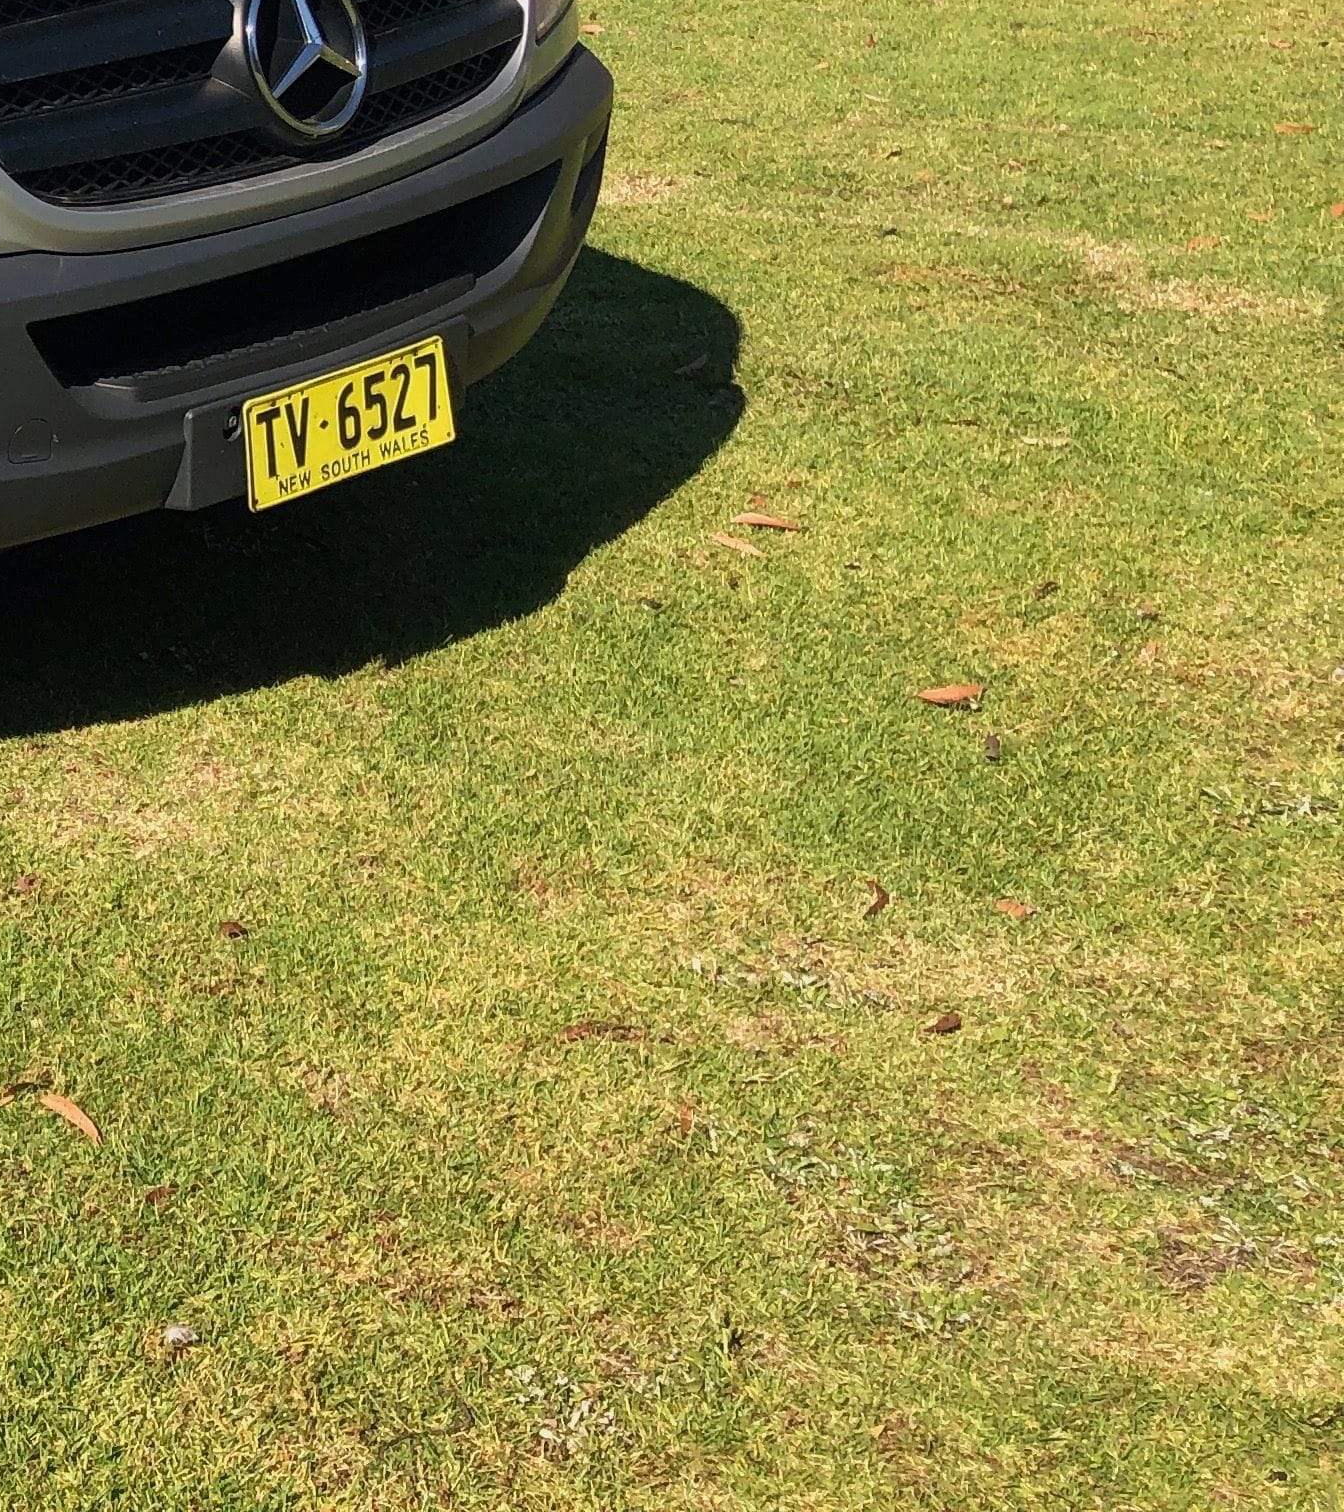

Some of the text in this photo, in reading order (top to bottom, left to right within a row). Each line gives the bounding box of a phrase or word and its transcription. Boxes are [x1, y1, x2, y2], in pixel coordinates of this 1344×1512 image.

[278, 429, 430, 497] NEW SOUTH WALES
